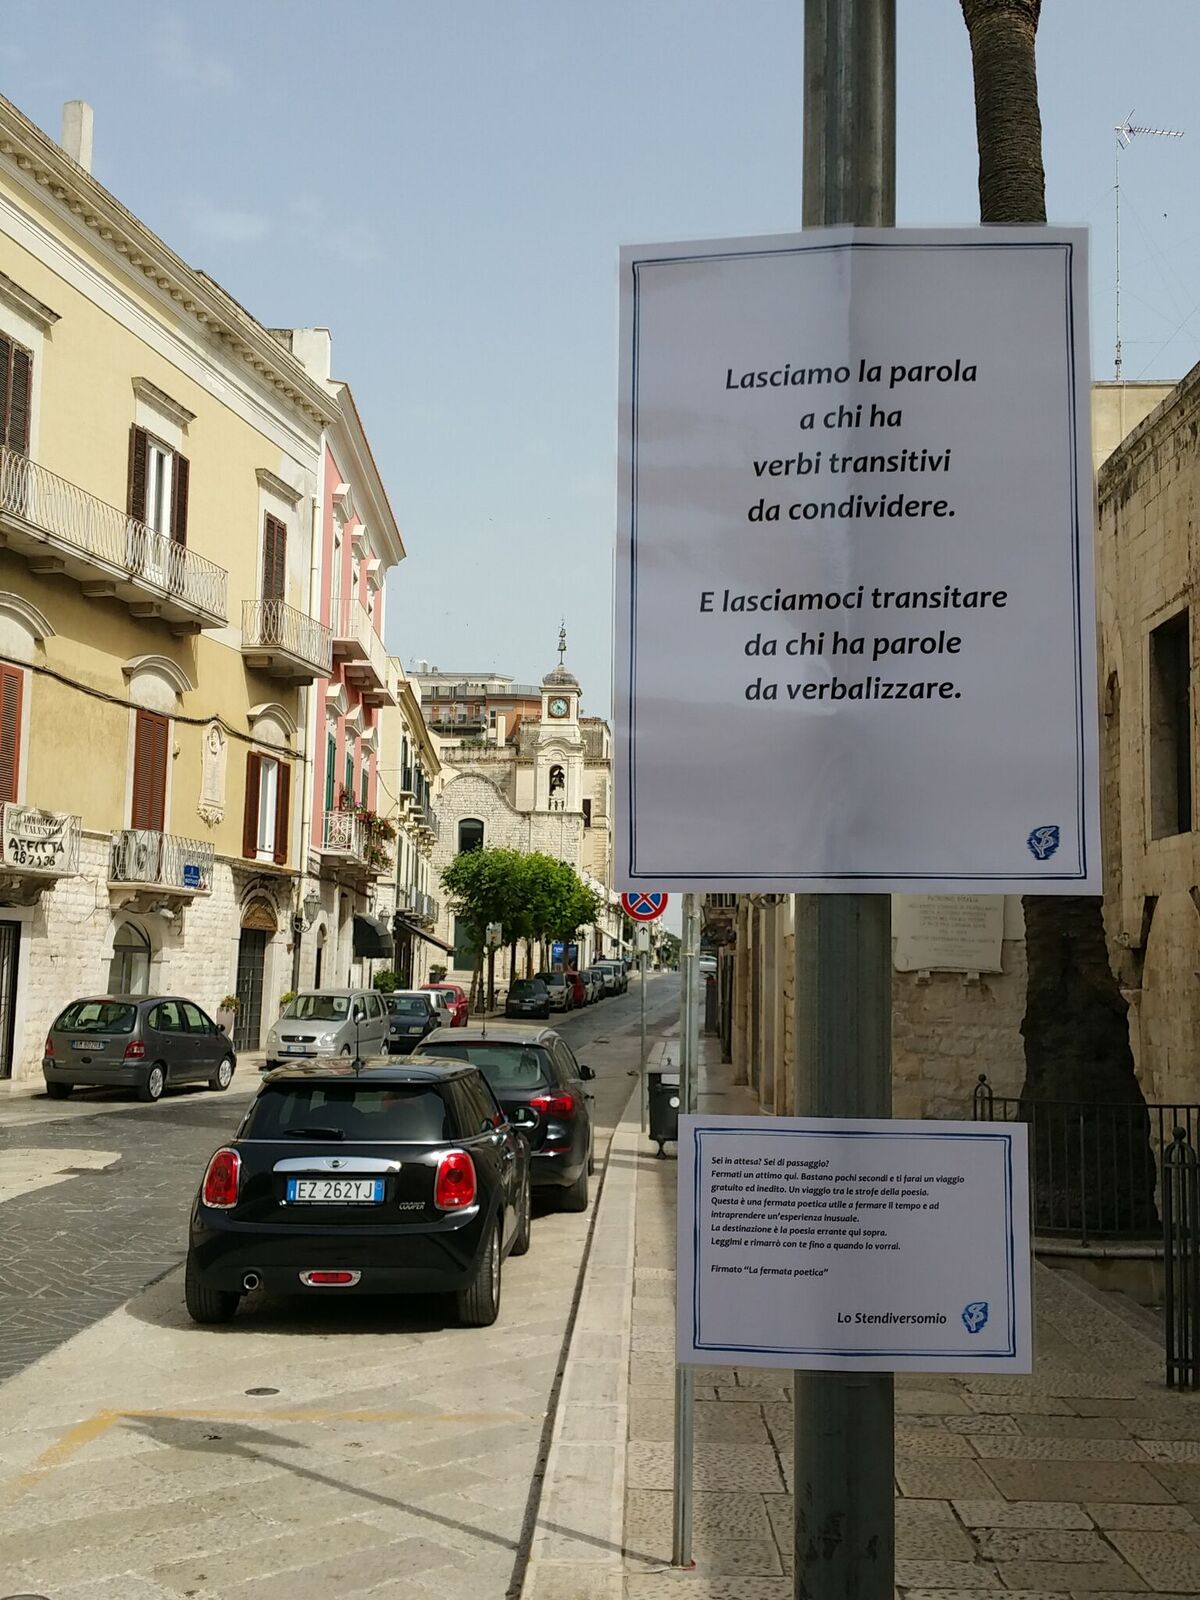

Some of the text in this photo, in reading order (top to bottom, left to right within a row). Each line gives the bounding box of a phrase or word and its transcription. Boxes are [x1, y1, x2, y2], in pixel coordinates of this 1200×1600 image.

[726, 359, 977, 390] Lasciamo la parola
[800, 403, 902, 430] a chi ha
[753, 449, 951, 477] verbi transitivi
[748, 495, 955, 522] da condividere.
[700, 584, 1008, 612] E lasciamoci transitare
[745, 630, 961, 662] da chi ha parole
[745, 677, 961, 701] da verbalizzare.
[8, 838, 64, 853] AFFITTA
[764, 1158, 776, 1166] Sei
[777, 1158, 786, 1166] di
[786, 1160, 830, 1169] passaggio?
[712, 1170, 743, 1178] Fermati
[784, 1172, 799, 1181] qui.
[801, 1173, 834, 1181] Bastano
[835, 1174, 857, 1183] pochi
[858, 1174, 889, 1182] secondi
[896, 1174, 903, 1182] ti
[904, 1174, 923, 1184] farai
[936, 1176, 966, 1185] viaggio
[298, 1182, 317, 1199] EZ
[323, 1182, 373, 1199] 262YJ
[711, 1184, 744, 1193] gratuito
[745, 1184, 756, 1192] ed
[757, 1185, 787, 1193] inedito.
[802, 1186, 833, 1196] viaggio
[846, 1187, 854, 1195] le
[855, 1188, 879, 1197] strofe
[901, 1188, 929, 1197] poesia.
[399, 1201, 426, 1210] COOPER
[711, 1197, 739, 1206] Questa
[740, 1197, 746, 1205] è
[764, 1198, 797, 1208] fermata
[797, 1200, 827, 1209] poetica
[829, 1200, 847, 1208] utile
[855, 1201, 888, 1210] fermare
[895, 1202, 922, 1211] tempo
[929, 1202, 940, 1210] ad
[711, 1210, 767, 1220] intraprendere
[824, 1214, 860, 1222] inusuale.
[722, 1224, 773, 1233] destinazione
[780, 1226, 788, 1234] la
[789, 1227, 816, 1236] poesia
[848, 1228, 862, 1238] qui
[863, 1230, 888, 1238] sopra.
[711, 1238, 743, 1248] Leggimi
[750, 1238, 782, 1247] rimarrò
[809, 1240, 826, 1250] fino
[833, 1242, 865, 1251] quando
[865, 1242, 874, 1250] lo
[875, 1242, 901, 1250] vorrai.
[711, 1265, 743, 1273] Firmato
[760, 1266, 793, 1276] fermata
[838, 1312, 946, 1324] Lo Stendiversomio
